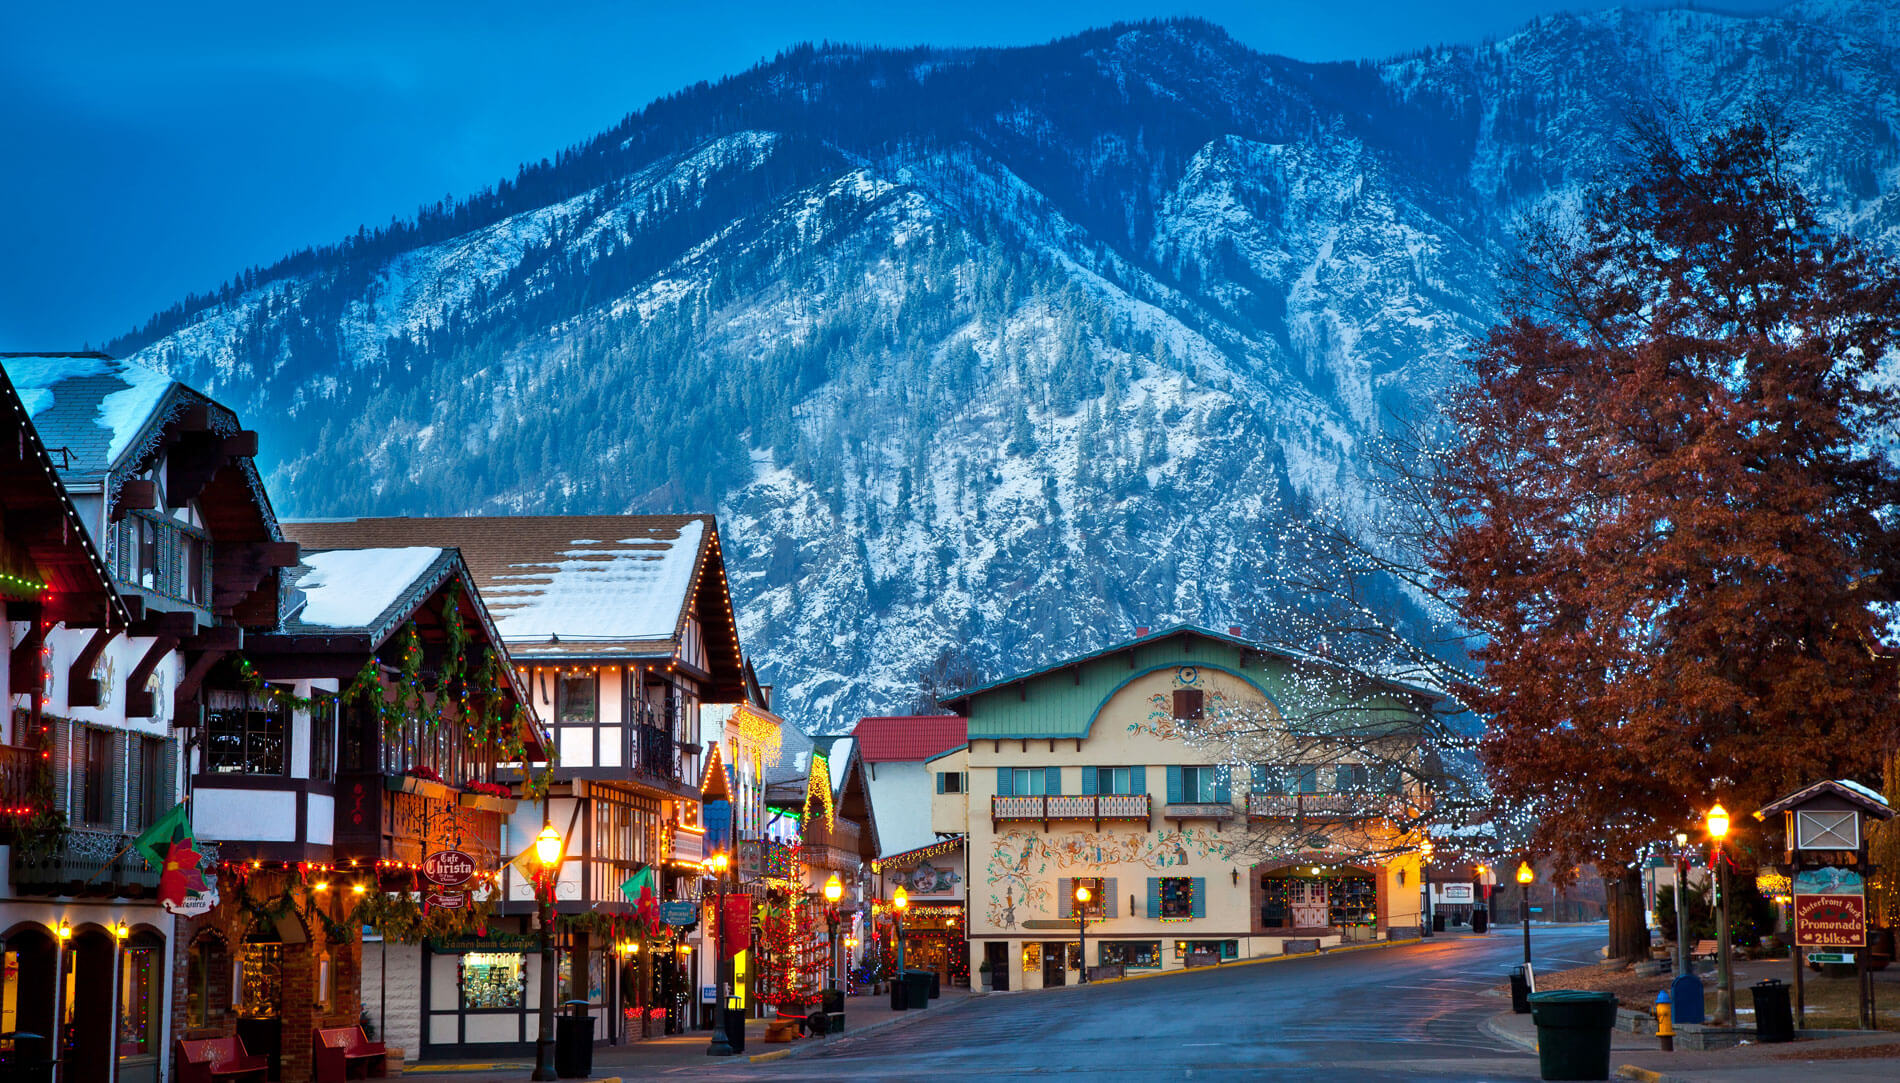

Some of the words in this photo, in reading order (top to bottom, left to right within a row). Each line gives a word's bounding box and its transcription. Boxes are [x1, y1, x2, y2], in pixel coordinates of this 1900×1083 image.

[440, 853, 459, 864] Cafe
[426, 860, 472, 878] Christa
[1799, 897, 1843, 917] Waterfront
[1845, 901, 1862, 919] Park
[1800, 919, 1862, 930] Promenade
